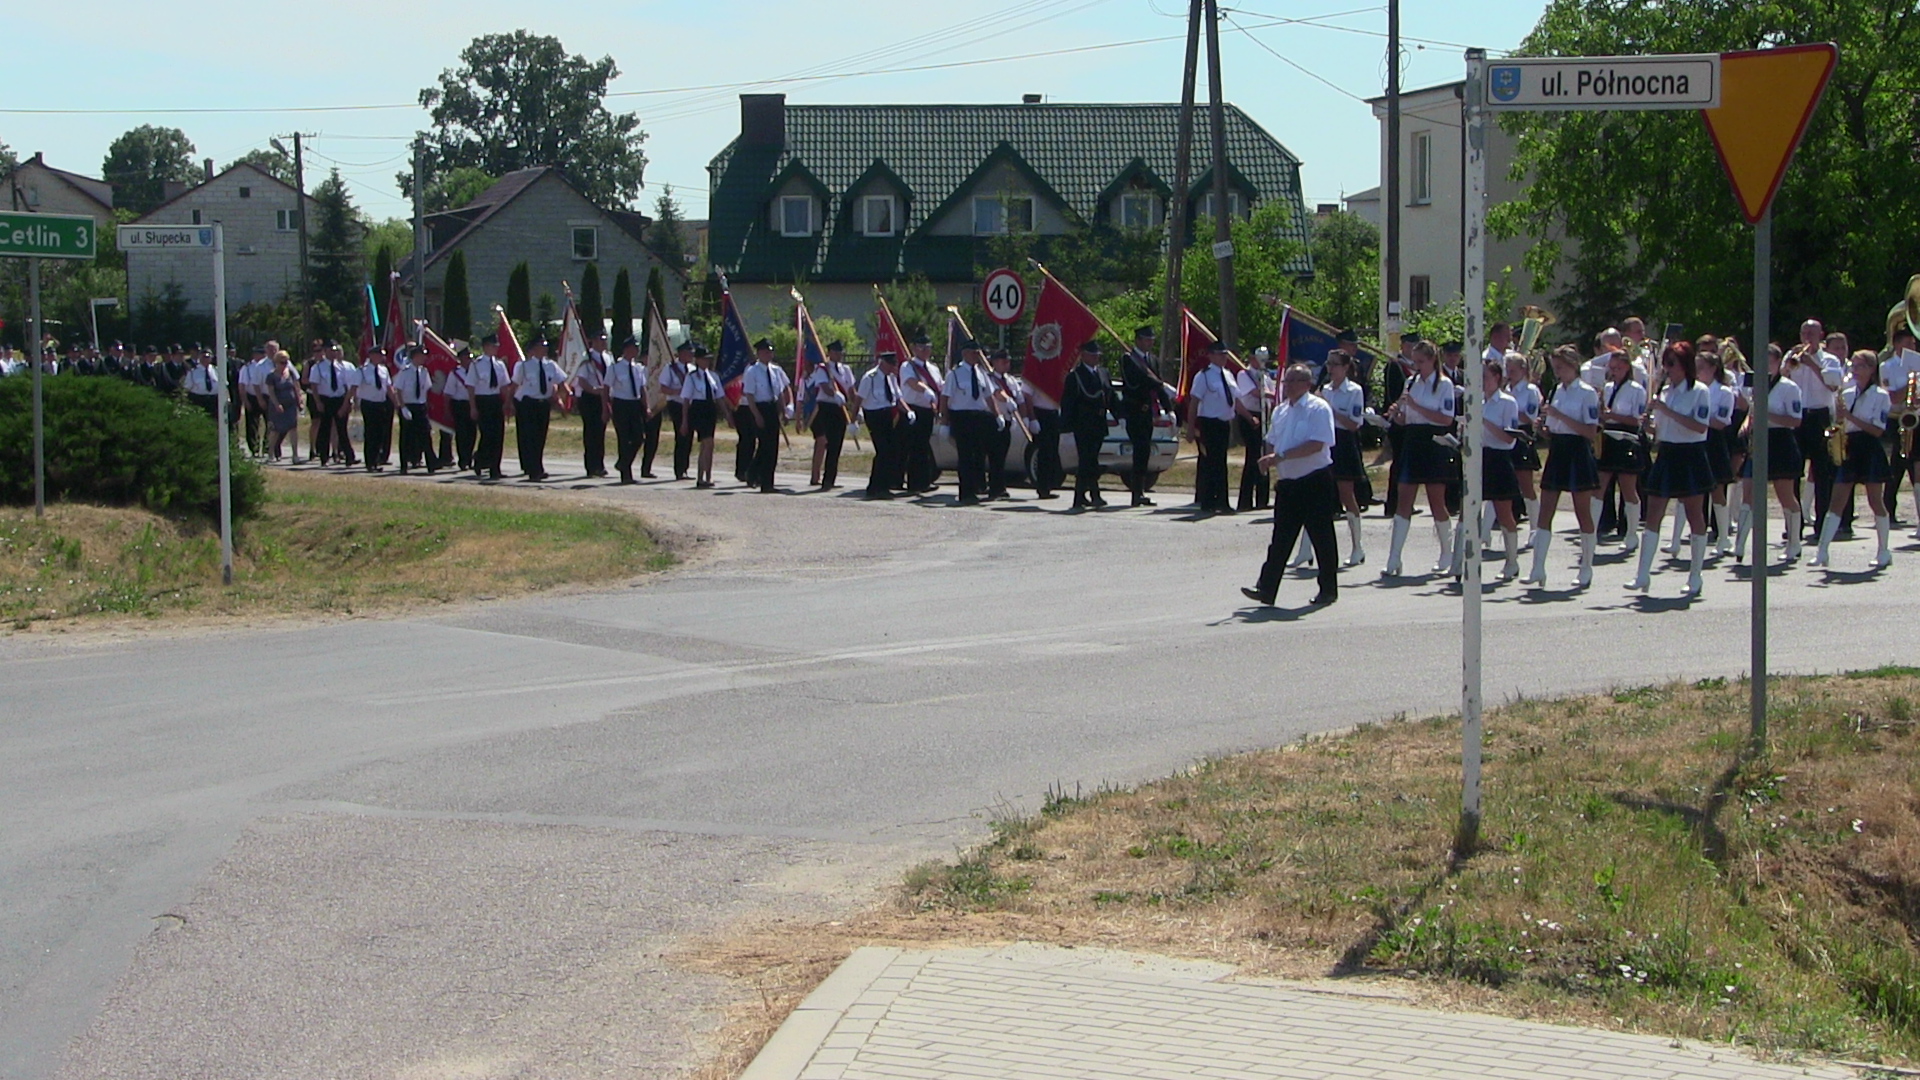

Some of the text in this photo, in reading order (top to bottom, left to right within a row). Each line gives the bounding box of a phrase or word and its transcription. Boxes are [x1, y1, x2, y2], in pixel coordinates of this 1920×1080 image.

[1542, 69, 1689, 96] ul. Północna
[0, 221, 89, 248] Cetlin 3
[130, 231, 191, 247] ul. Słupecka
[989, 284, 1019, 309] 40
